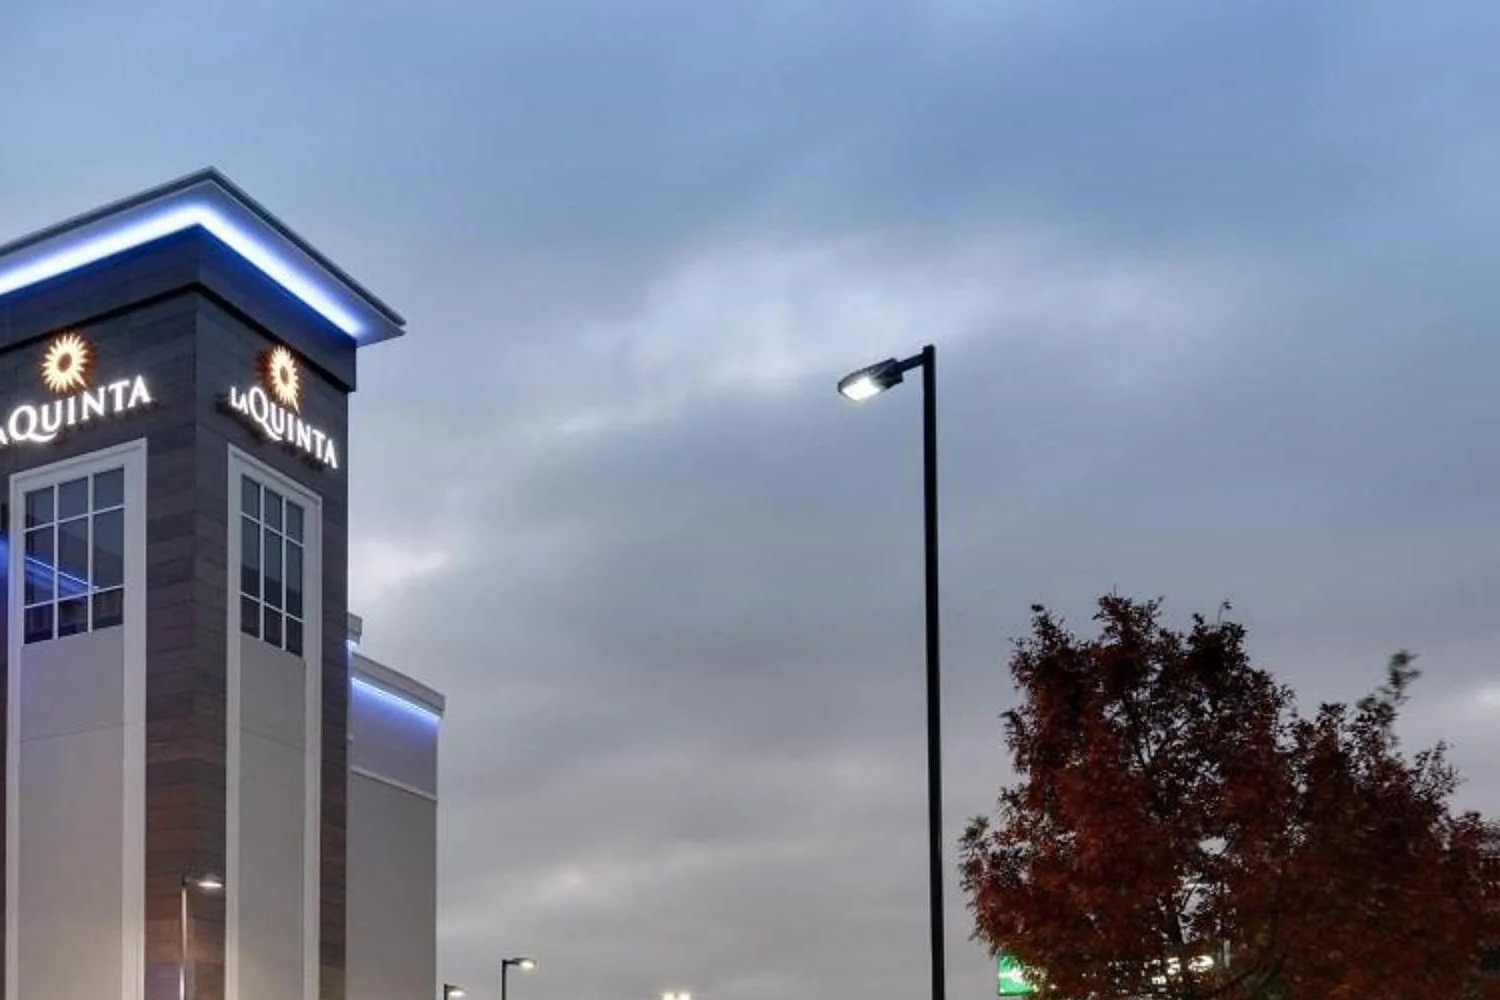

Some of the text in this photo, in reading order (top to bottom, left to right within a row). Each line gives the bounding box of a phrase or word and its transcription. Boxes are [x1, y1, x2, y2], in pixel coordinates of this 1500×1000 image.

[8, 373, 153, 442] QUINTA
[230, 386, 338, 469] LA QUINTA
